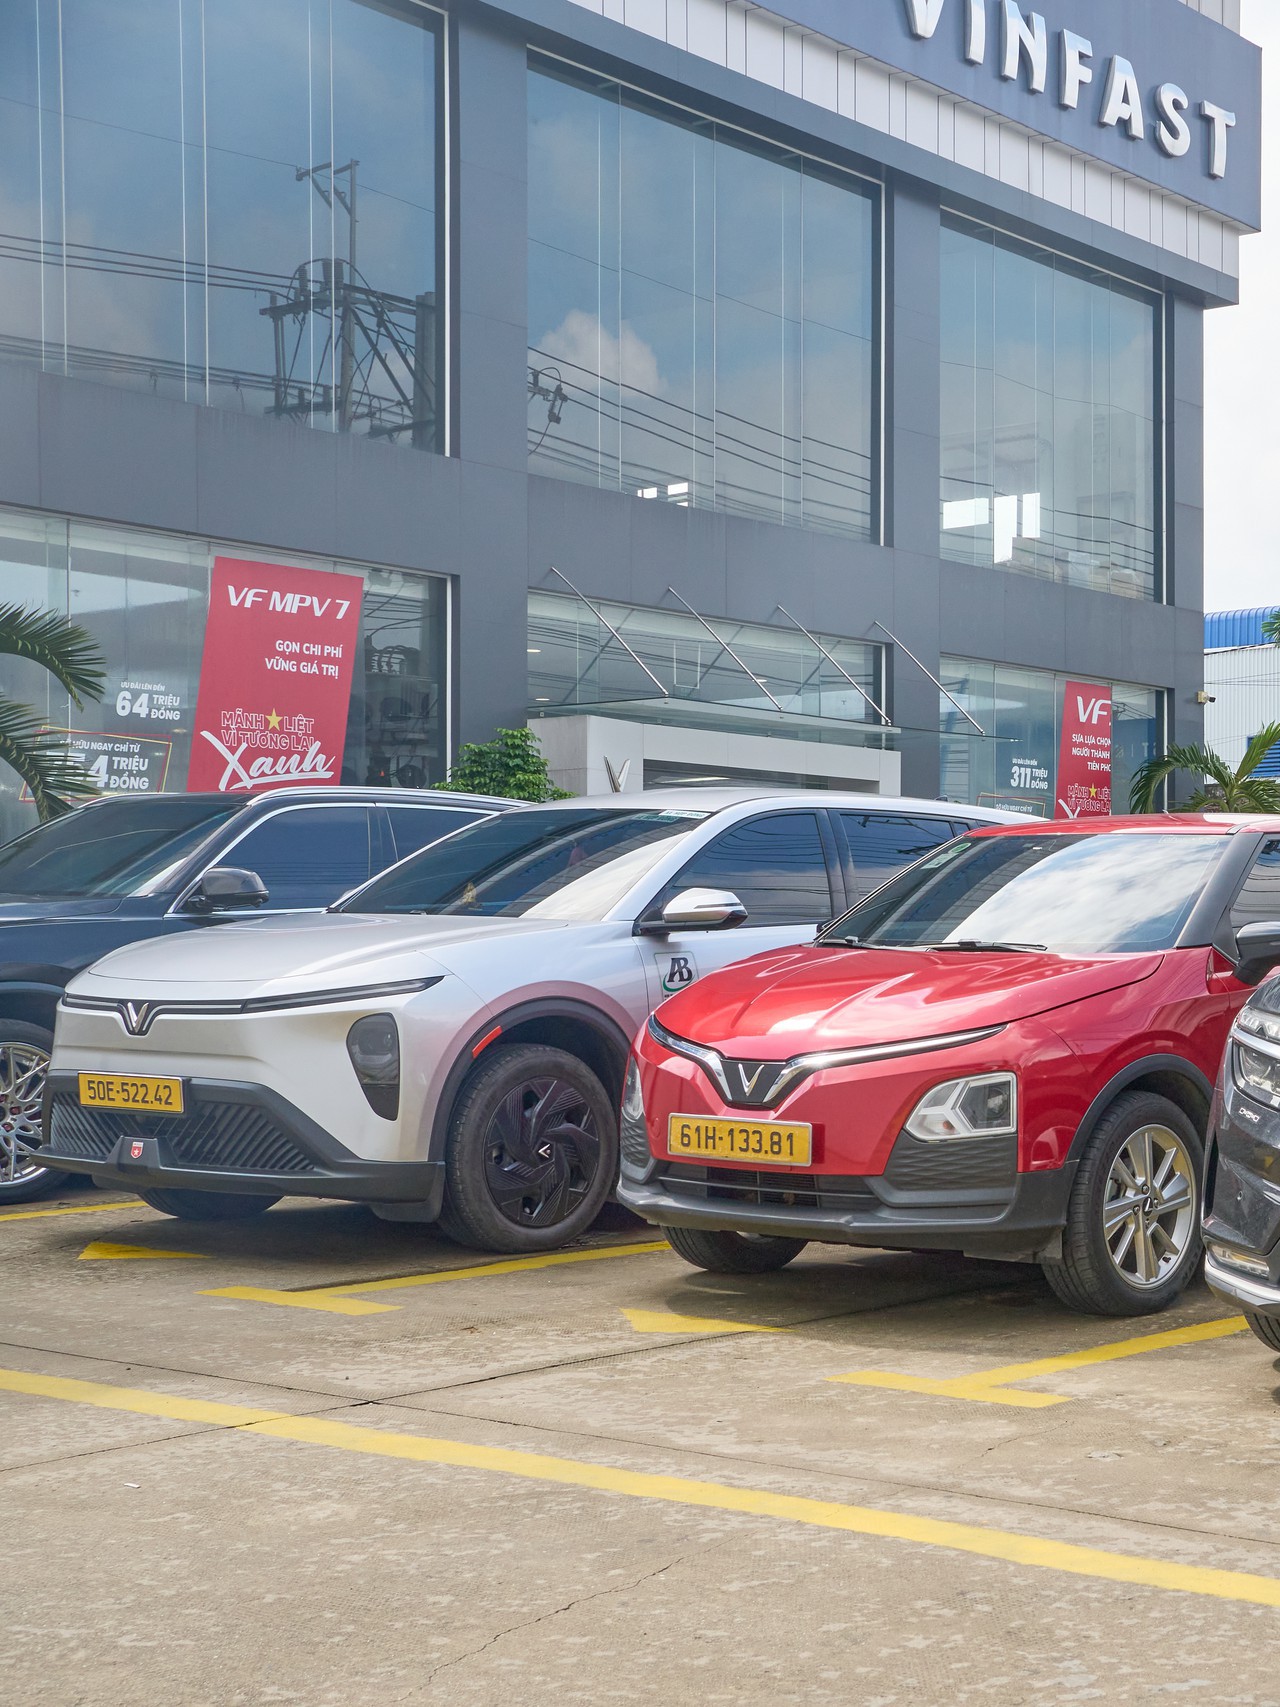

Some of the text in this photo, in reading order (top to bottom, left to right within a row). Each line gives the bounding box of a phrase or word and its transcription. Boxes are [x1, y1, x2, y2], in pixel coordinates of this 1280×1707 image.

[227, 585, 350, 620] VF MPV 7
[275, 640, 343, 658] GỌN CHI PHÍ
[265, 656, 339, 679] VỮNG GIÁ TRỊ
[116, 690, 180, 718] 64 TRIỆU
[150, 706, 180, 720] ĐỒNG
[1077, 696, 1111, 724] VF
[221, 708, 314, 737] MÃNH LIỆT
[90, 742, 113, 751] NGAY
[114, 742, 129, 752] CHỈ
[129, 743, 140, 753] TỪ
[221, 727, 237, 746] VÌ
[239, 731, 289, 750] TƯƠNG
[112, 756, 149, 774] TRIỆU
[200, 731, 336, 791] Xanh
[1091, 748, 1110, 759] THÀNH
[110, 771, 149, 790] ĐỒNG
[1010, 765, 1031, 788] 311
[667, 957, 692, 982] AB
[87, 1080, 173, 1105] 50E-522.42
[680, 1124, 794, 1156] 61H-133.81
